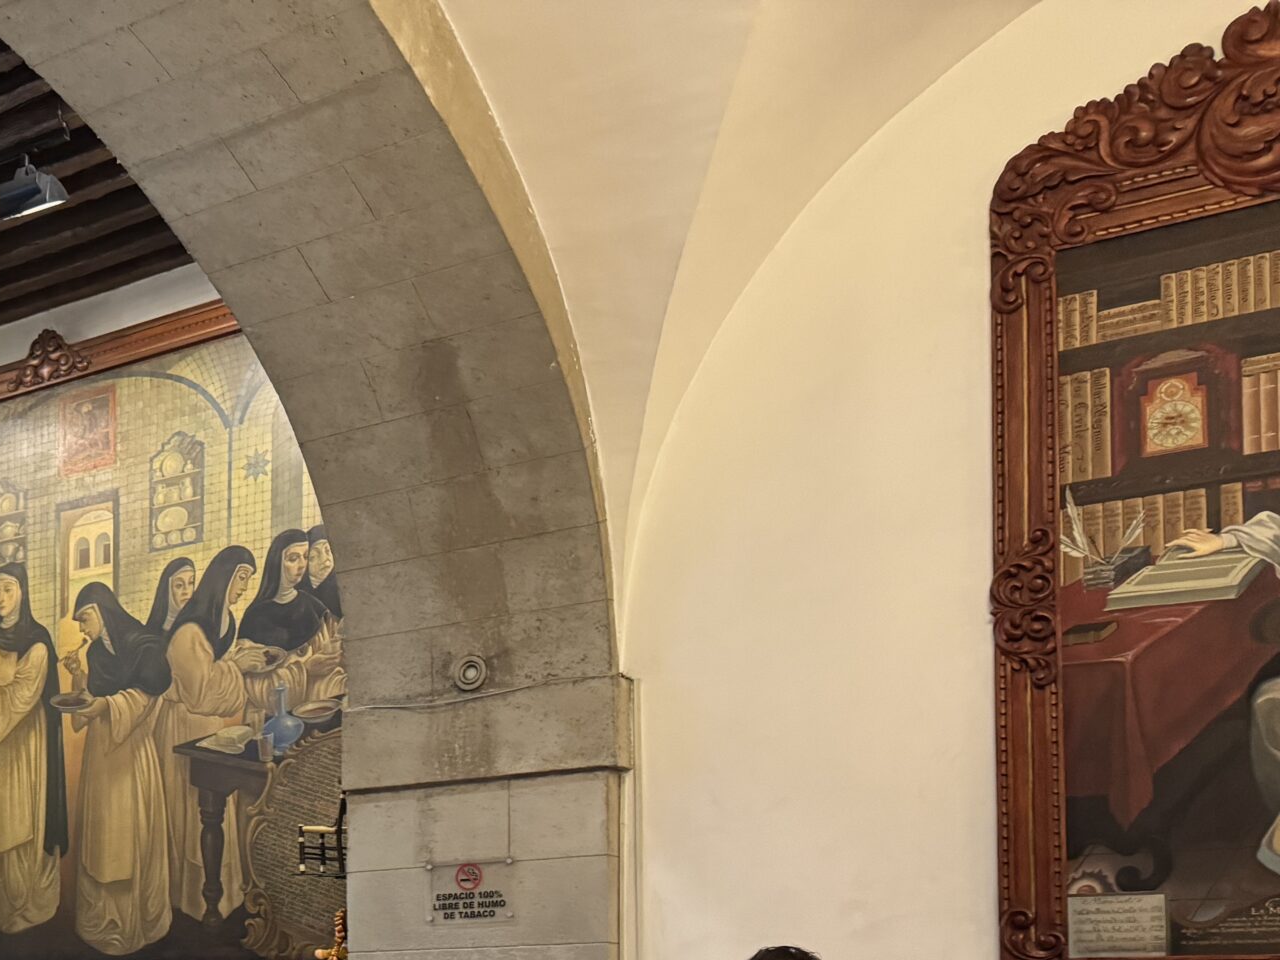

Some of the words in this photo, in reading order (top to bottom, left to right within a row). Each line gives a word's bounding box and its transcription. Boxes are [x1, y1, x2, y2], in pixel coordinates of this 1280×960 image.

[436, 891, 475, 901] ESPACIO
[478, 890, 503, 899] 100%
[433, 902, 460, 911] LIBRE
[463, 901, 475, 909] DE
[477, 899, 506, 908] HUMO
[443, 911, 455, 920] DE
[458, 909, 496, 919] TABACO
